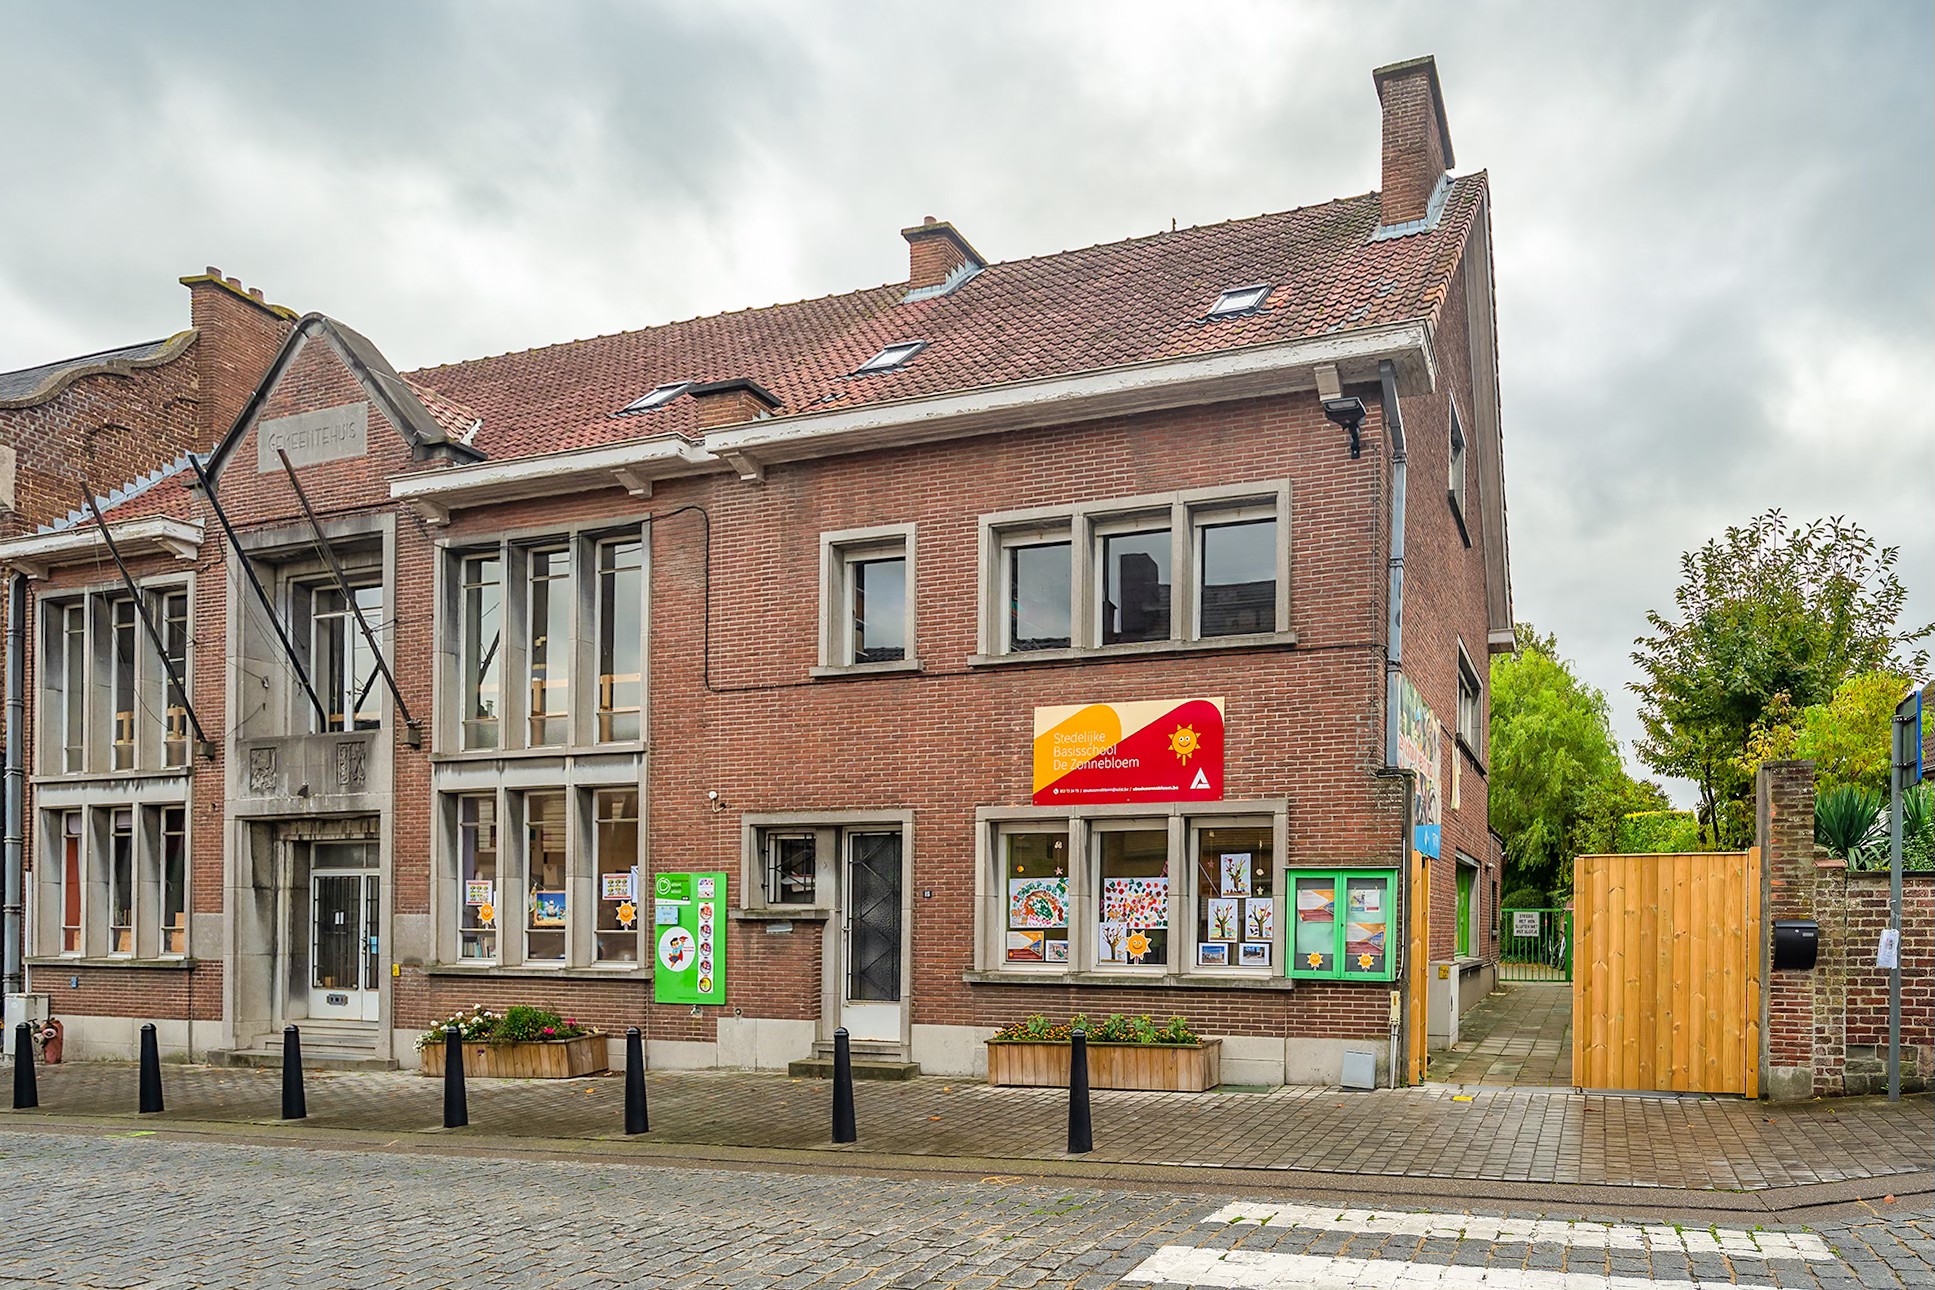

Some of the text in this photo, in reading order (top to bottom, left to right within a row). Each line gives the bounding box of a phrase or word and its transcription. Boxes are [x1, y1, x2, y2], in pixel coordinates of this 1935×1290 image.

[268, 422, 356, 453] GEMEENTEHUIS
[1053, 731, 1106, 746] Stedelijke
[1053, 743, 1117, 757] Basisschool
[1053, 756, 1140, 770] De Zonnebloem
